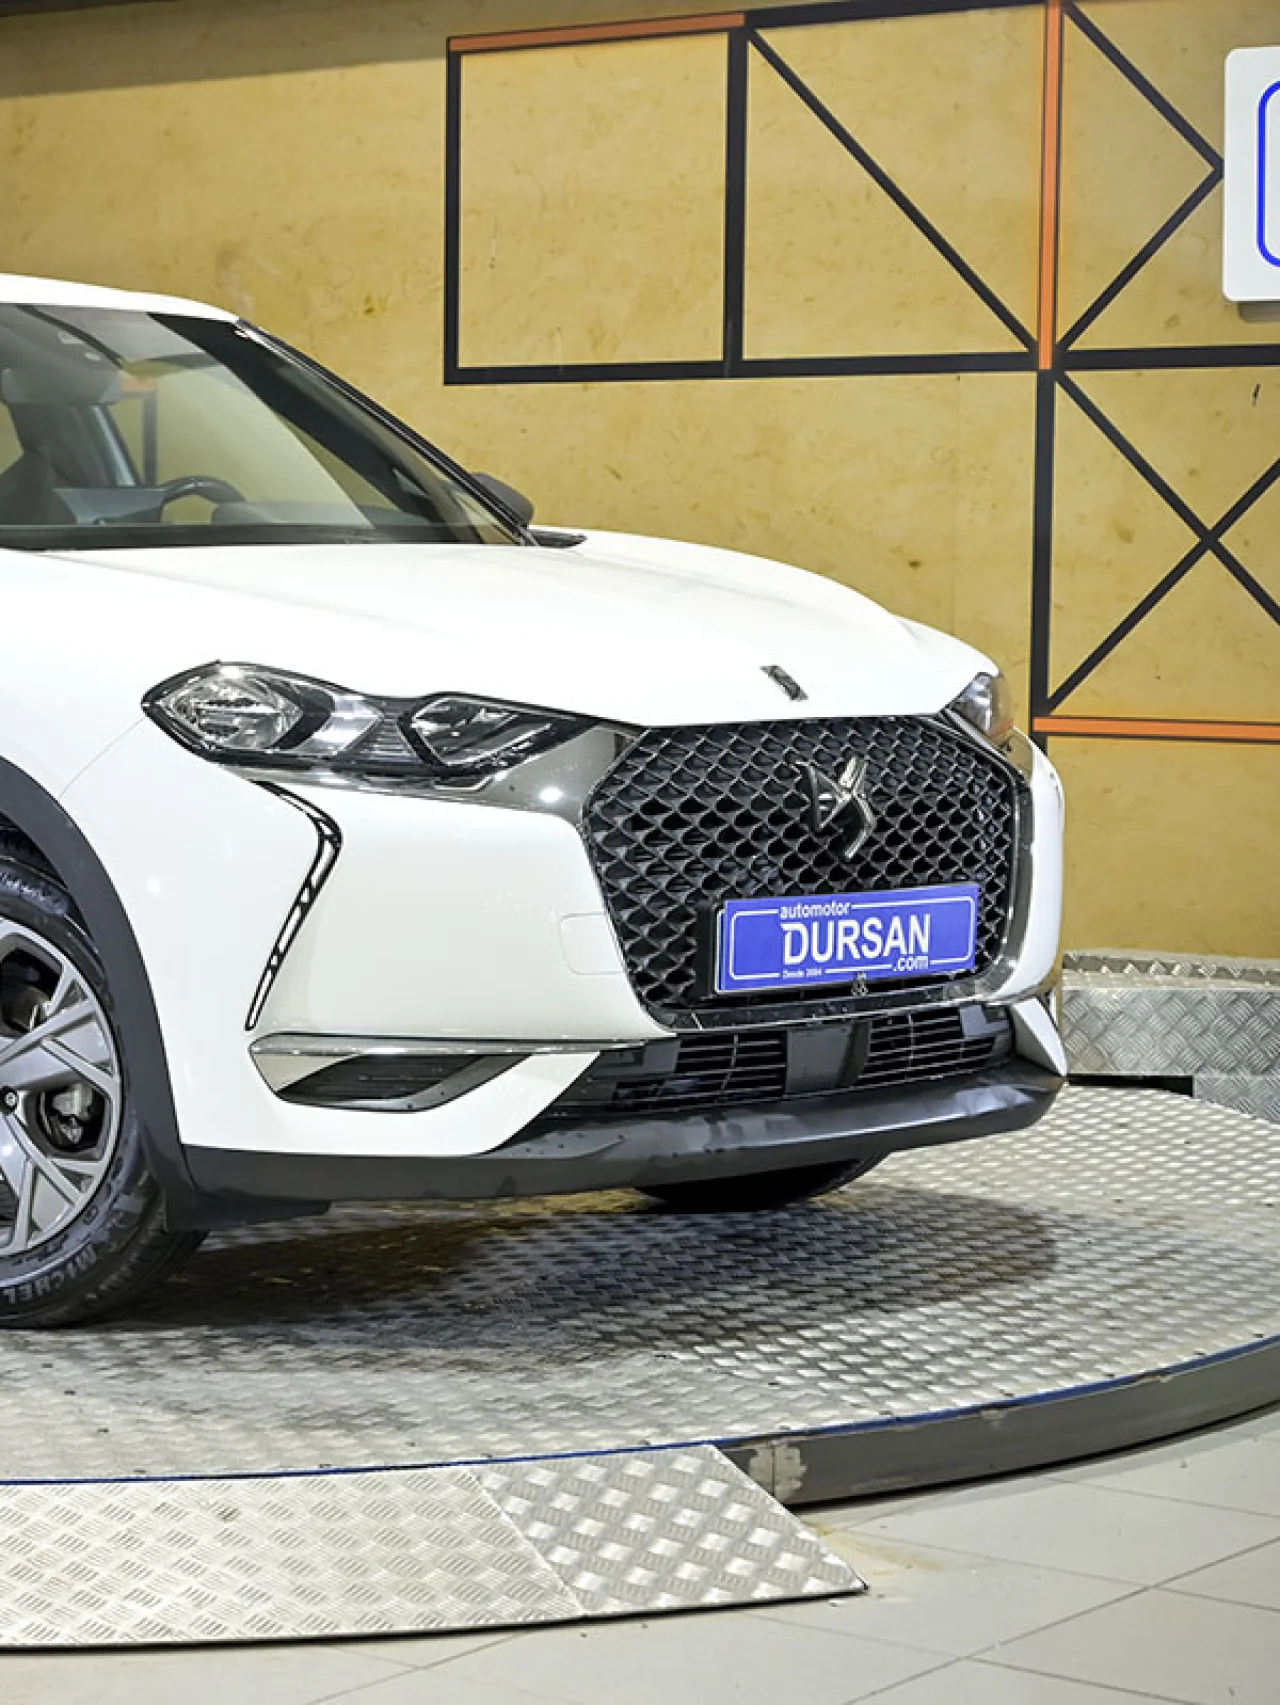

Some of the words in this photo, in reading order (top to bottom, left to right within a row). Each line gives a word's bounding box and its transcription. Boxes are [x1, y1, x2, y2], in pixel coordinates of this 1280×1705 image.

[780, 900, 851, 919] automotor
[780, 913, 931, 966] DURSAN
[893, 955, 929, 972] .com
